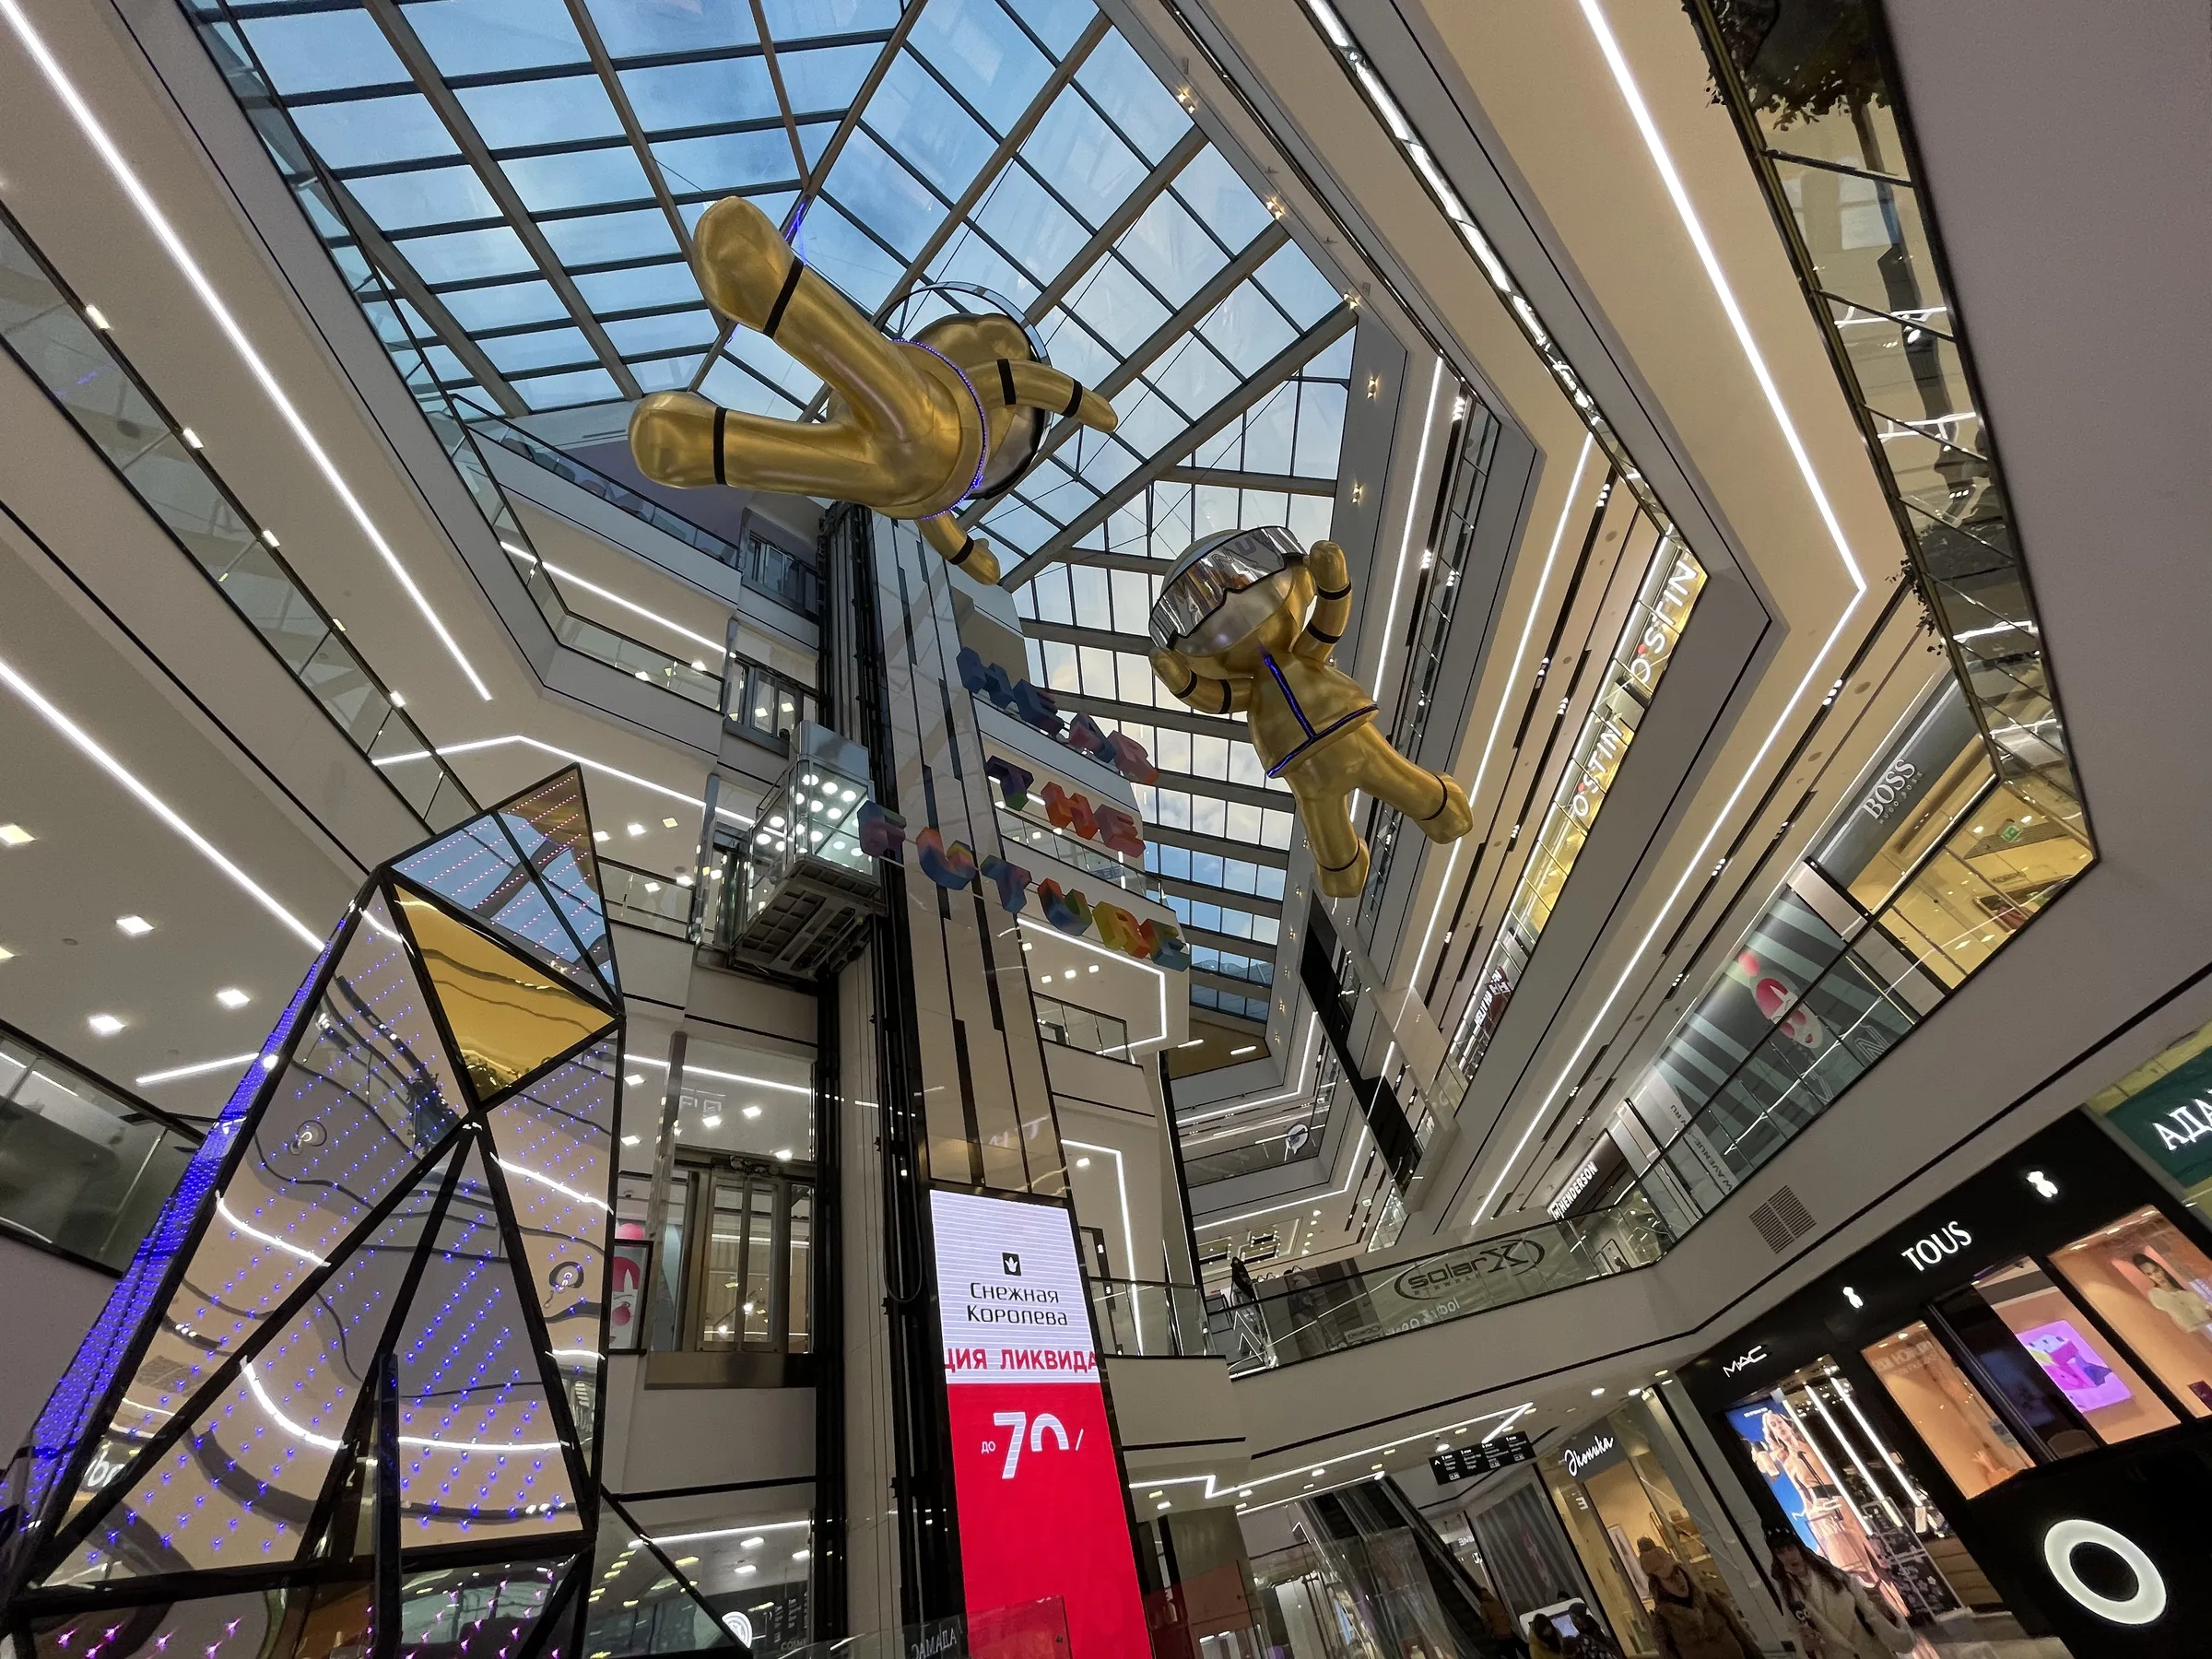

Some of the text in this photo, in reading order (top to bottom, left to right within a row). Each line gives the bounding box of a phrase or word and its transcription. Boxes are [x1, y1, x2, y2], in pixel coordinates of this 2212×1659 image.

[985, 756, 1146, 858] THE
[1863, 759, 1915, 819] BOSS
[857, 800, 1190, 971] FUTURE
[1483, 969, 1502, 1005] HAEN
[2152, 1088, 2212, 1151] АДА
[1559, 1160, 1599, 1214] HENDERSON
[1900, 1220, 1972, 1272] TOUS
[967, 1305, 1068, 1325] Королева
[970, 1282, 1060, 1303] Снежная
